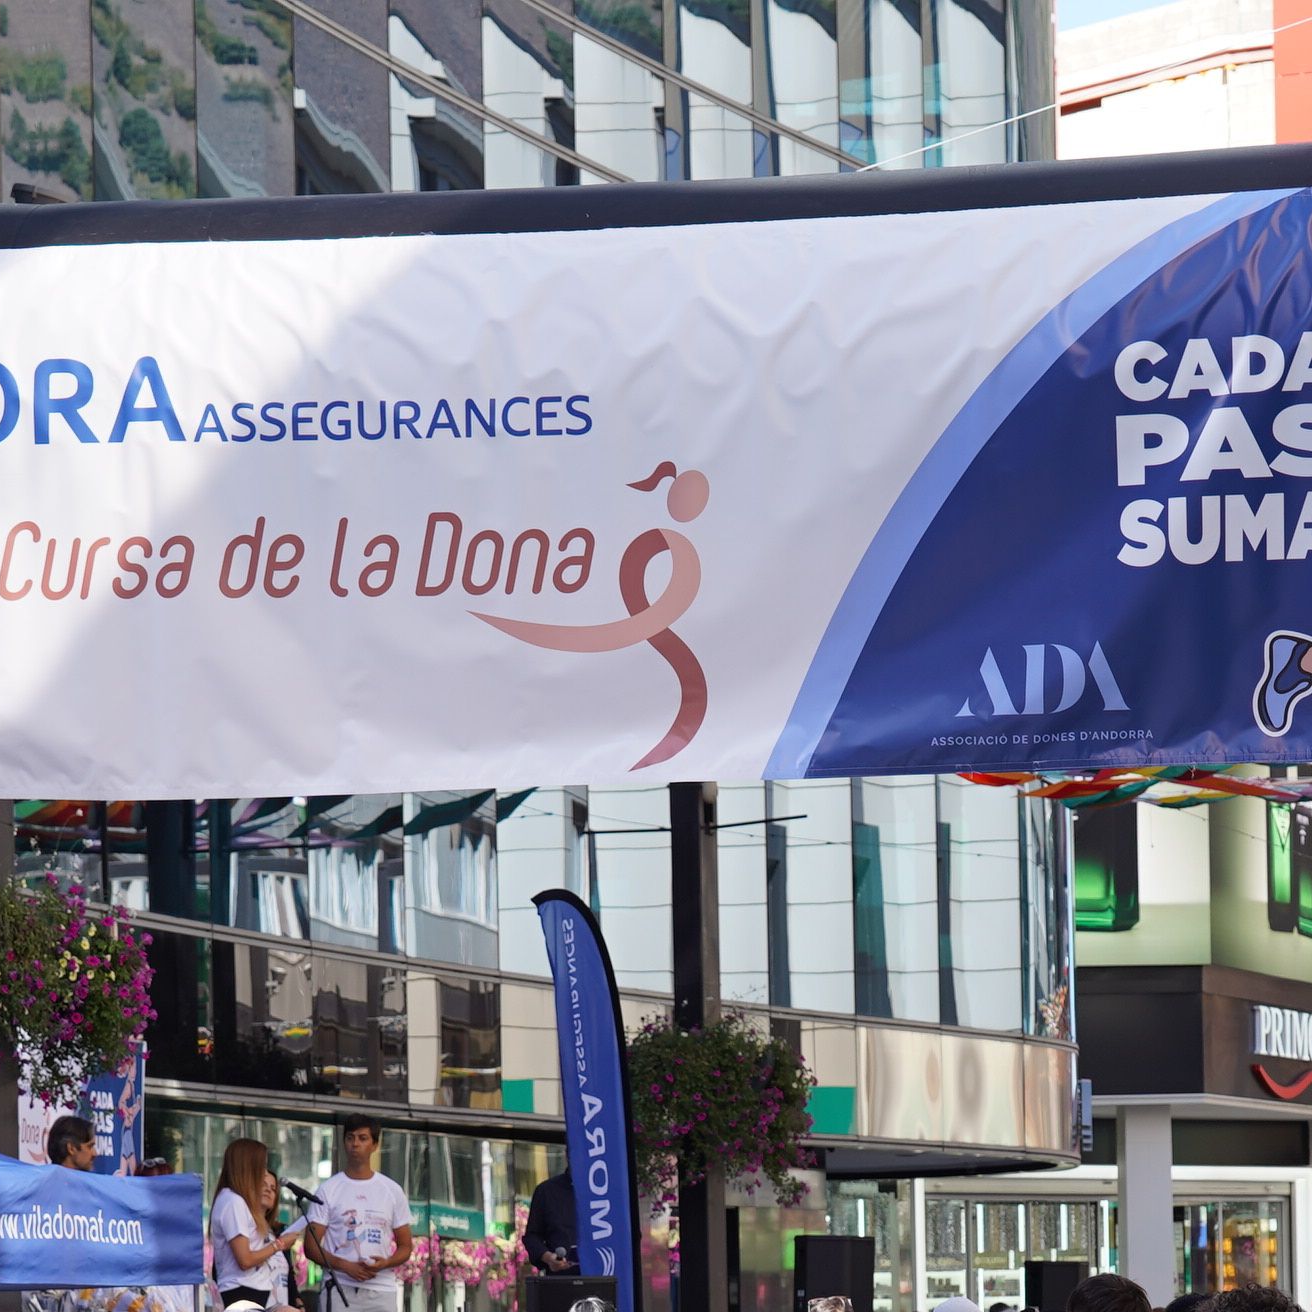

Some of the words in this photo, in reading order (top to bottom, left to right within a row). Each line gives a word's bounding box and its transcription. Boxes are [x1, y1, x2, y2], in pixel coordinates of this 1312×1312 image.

[195, 394, 593, 443] ASSEGURANCES
[218, 516, 304, 597] de
[328, 516, 399, 596] la
[415, 511, 594, 597] Dona
[955, 640, 1131, 717] ADA
[931, 734, 1008, 746] ASSOCIACIÓ
[1012, 735, 1028, 744] DE
[1033, 732, 1076, 744] DONES
[1080, 729, 1153, 741] D'ANDORRA
